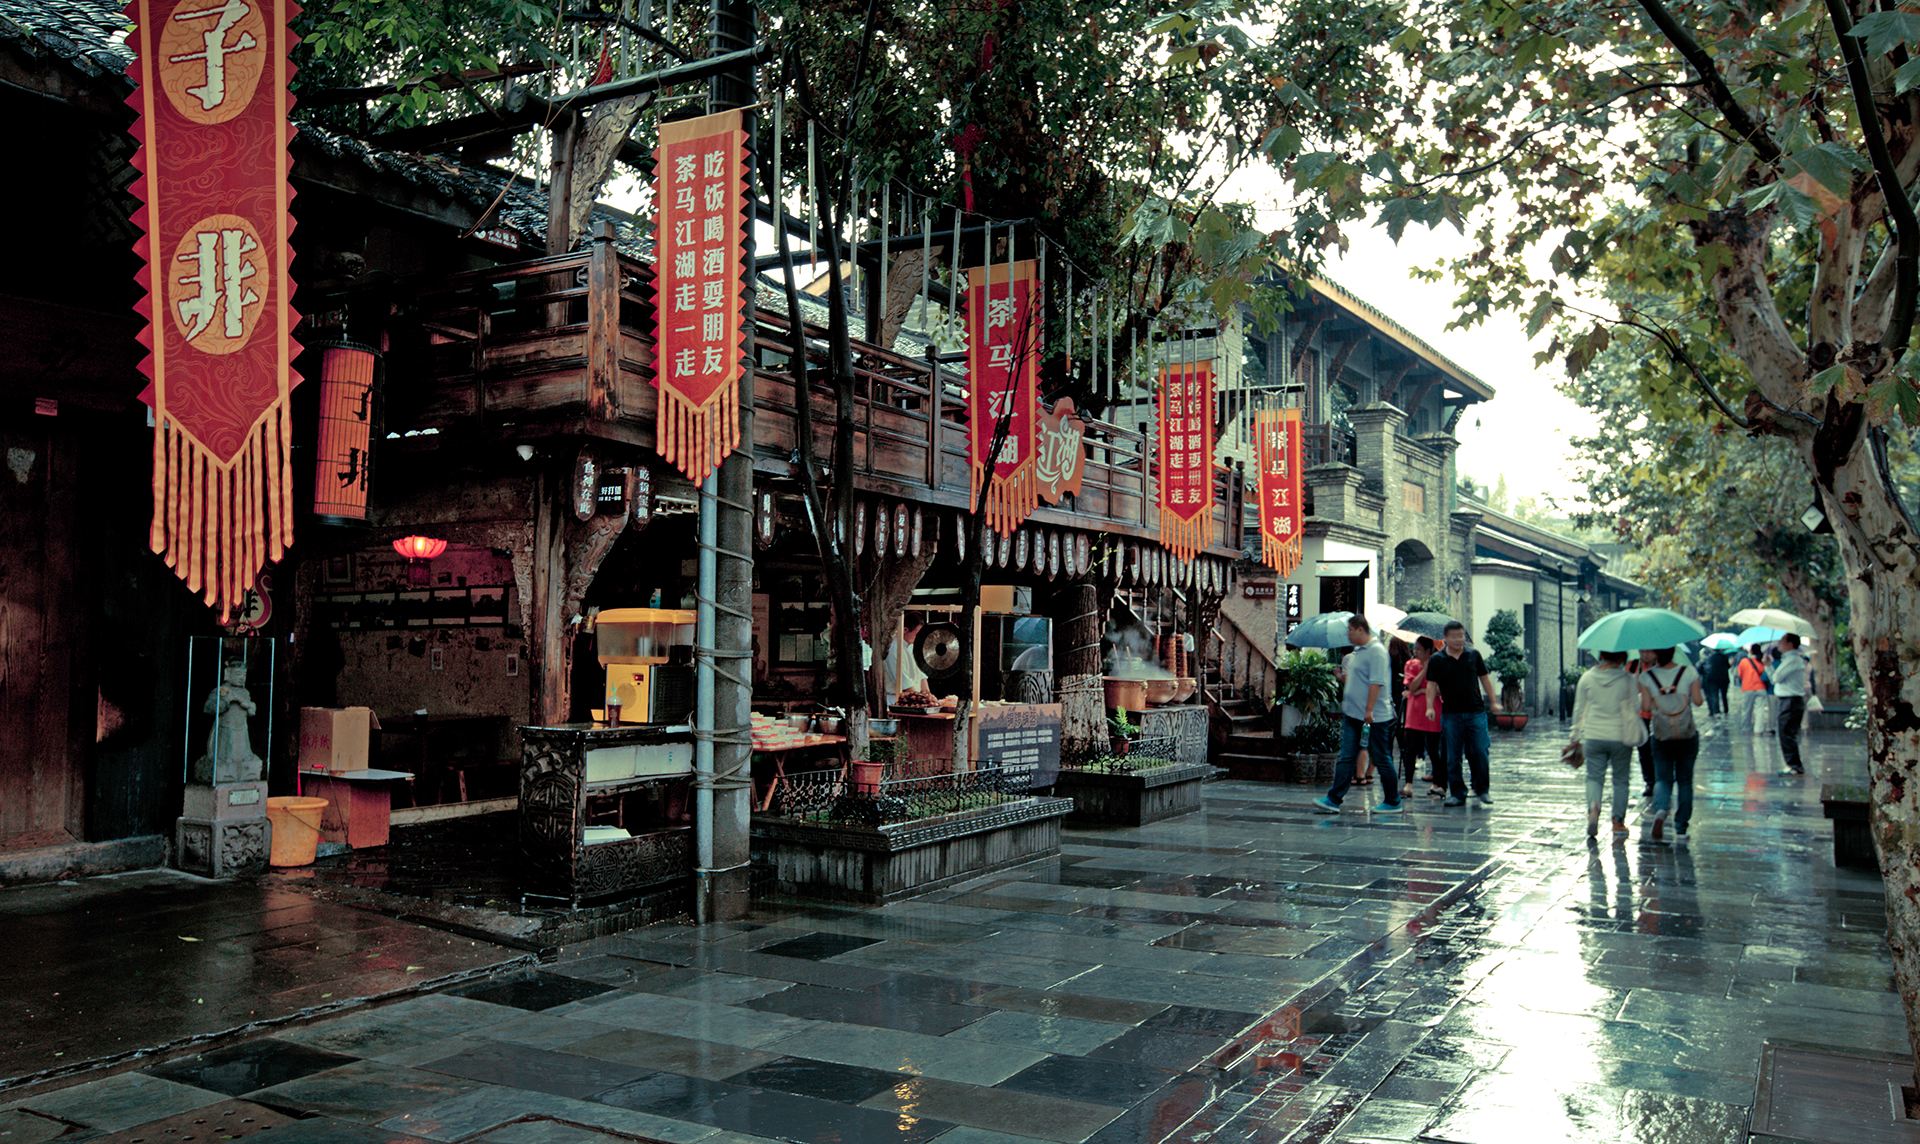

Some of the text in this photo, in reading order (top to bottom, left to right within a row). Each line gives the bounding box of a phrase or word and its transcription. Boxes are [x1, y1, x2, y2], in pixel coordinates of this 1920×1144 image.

[674, 155, 697, 378] 茶马江湖走一走
[701, 151, 726, 376] 吃饭喝酒耍朋友
[987, 297, 1018, 464] 茶马江湖
[1268, 431, 1291, 535] 茶马江湖
